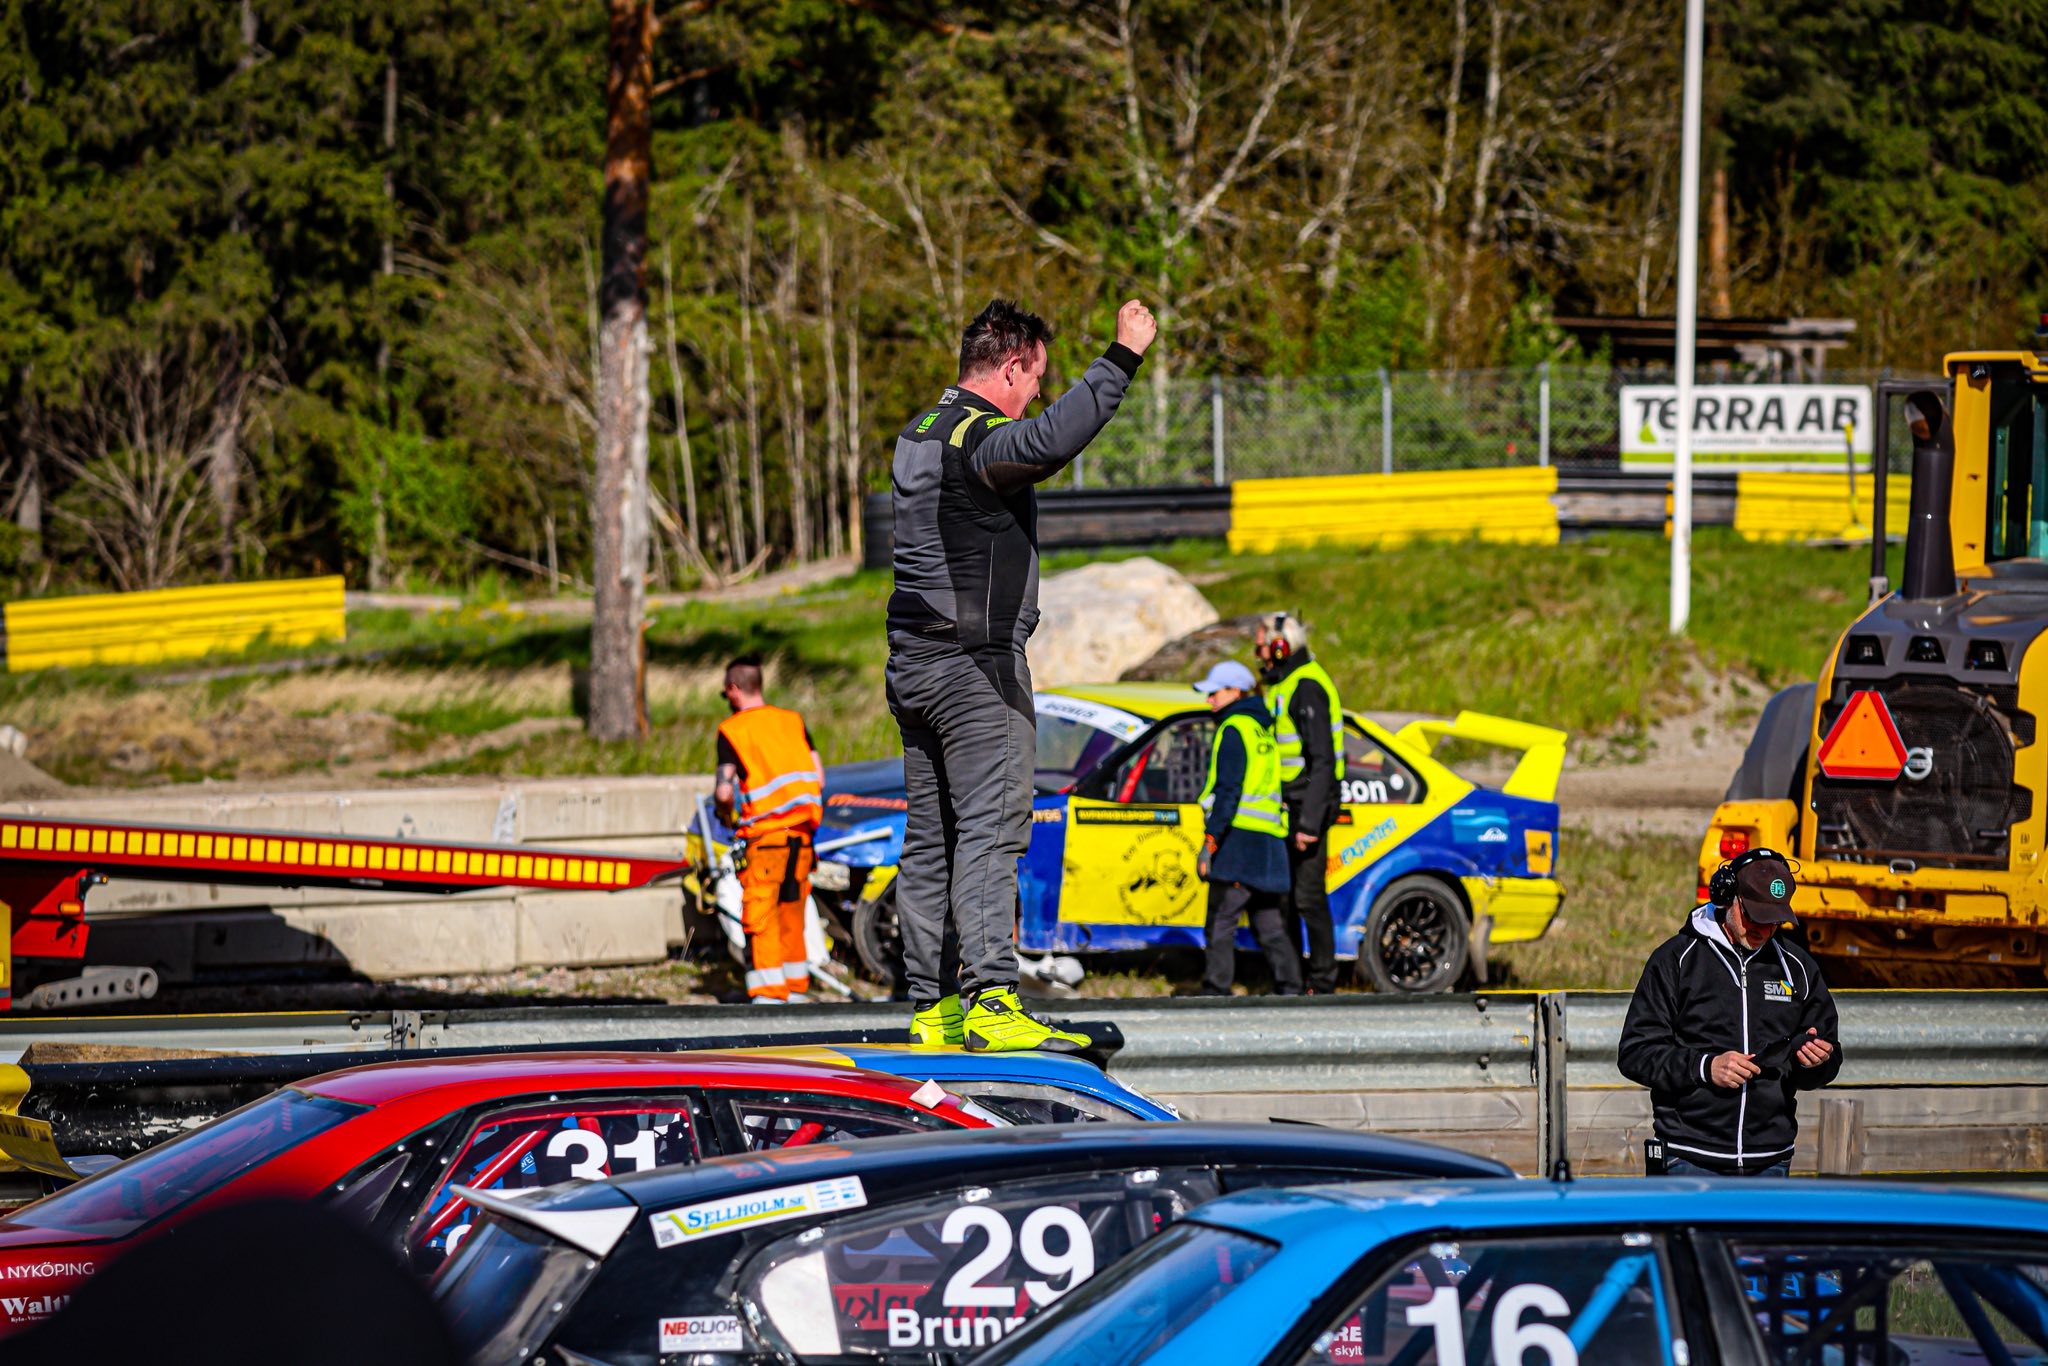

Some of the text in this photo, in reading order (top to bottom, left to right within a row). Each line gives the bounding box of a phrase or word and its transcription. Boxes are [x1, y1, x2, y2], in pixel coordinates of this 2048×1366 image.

[1633, 396, 1858, 432] TERRA AB
[1763, 983, 1786, 996] SM
[546, 1129, 656, 1181] 31
[7, 1261, 95, 1279] NYKÖPING
[941, 1205, 1095, 1307] 29
[1406, 1283, 1578, 1366] 16
